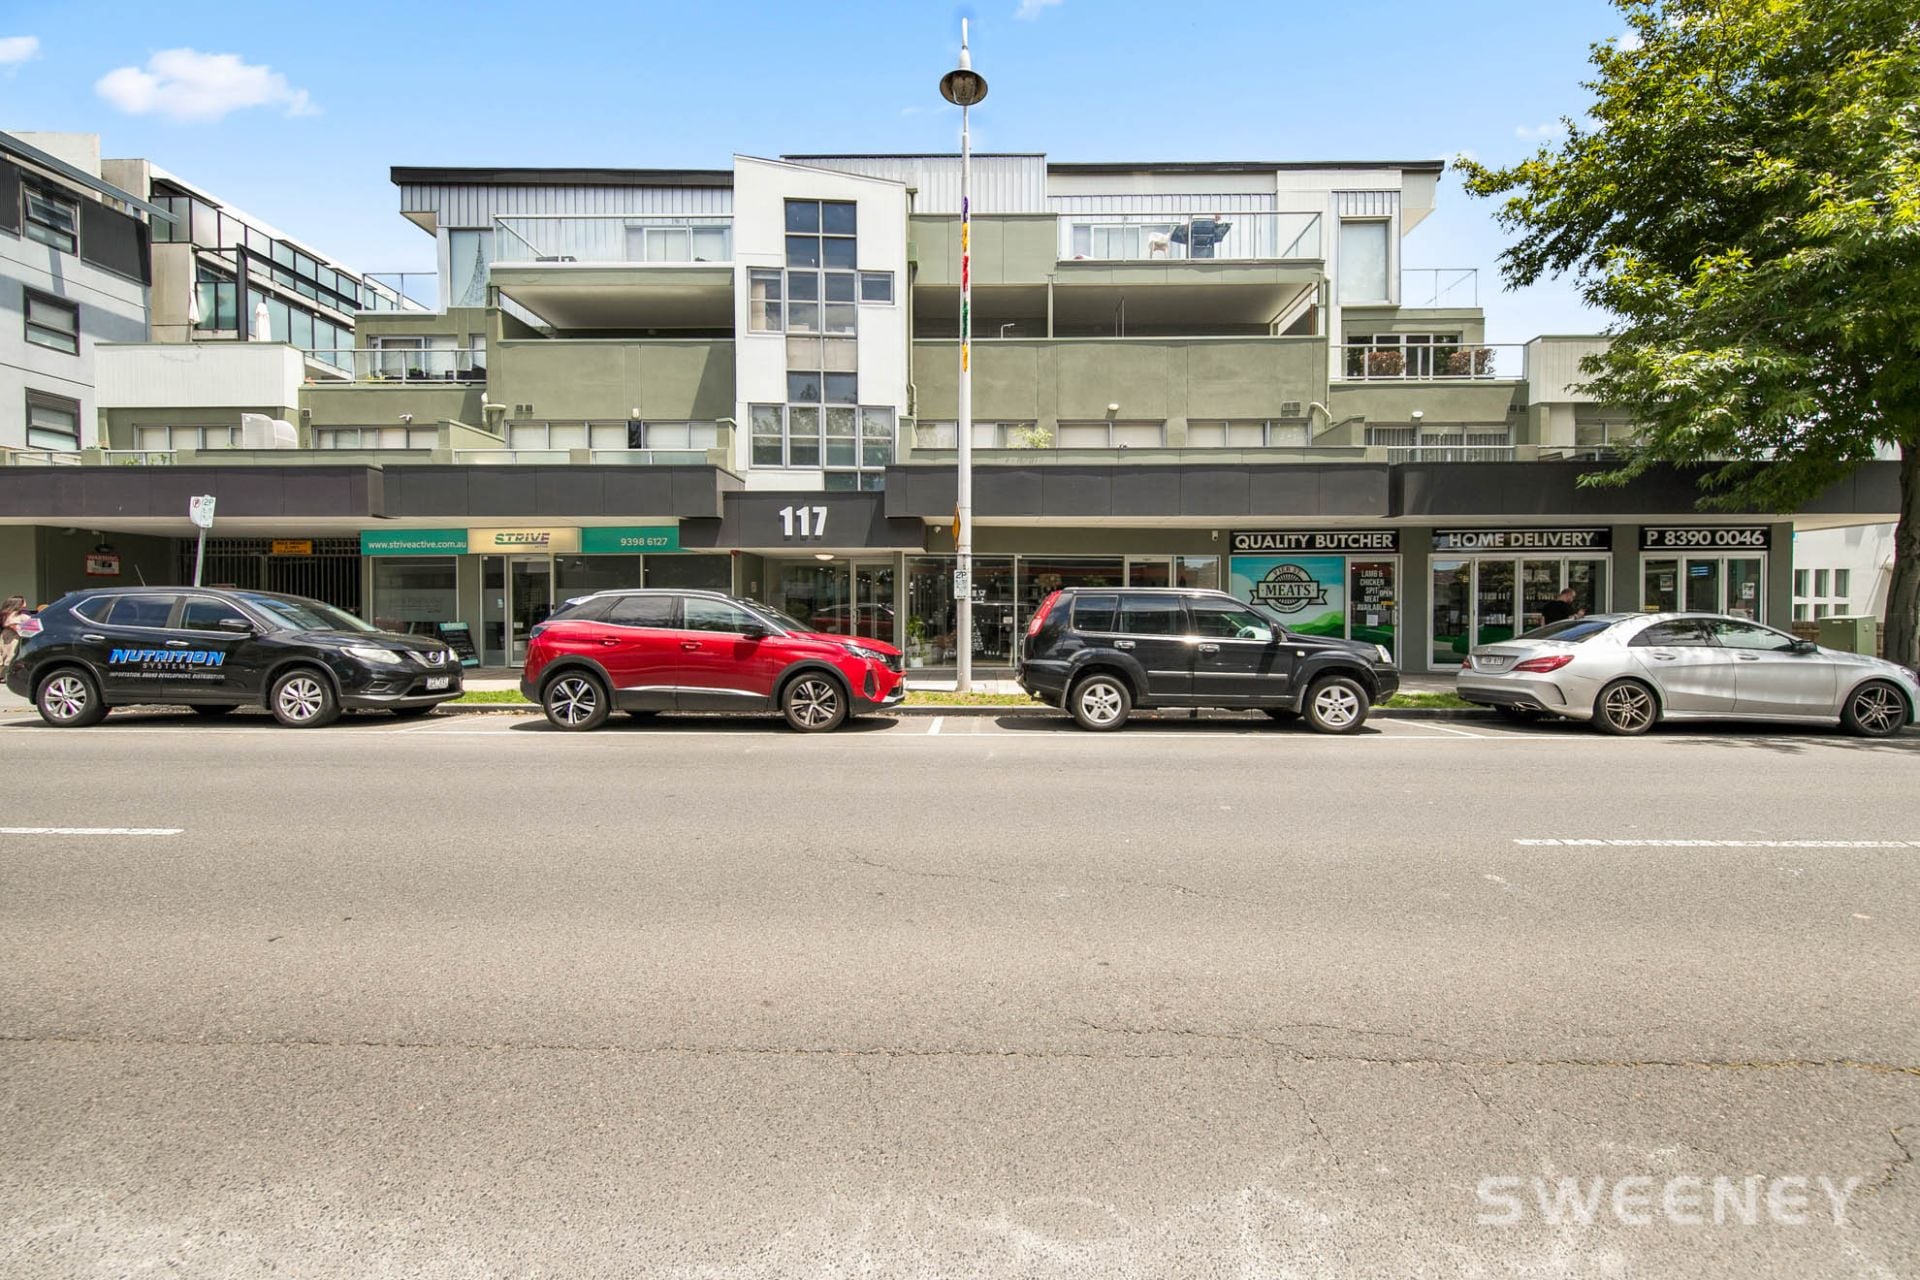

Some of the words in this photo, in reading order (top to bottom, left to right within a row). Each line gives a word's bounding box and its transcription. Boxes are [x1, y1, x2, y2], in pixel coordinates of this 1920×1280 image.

[779, 506, 828, 537] 117
[495, 533, 550, 542] STRIVE
[620, 537, 645, 546] 9398
[646, 537, 668, 546] 6127
[1235, 534, 1310, 549] QUALITY
[1315, 534, 1393, 548] BUTCHER
[1448, 532, 1504, 547] HOME
[1511, 532, 1595, 547] DELIVERY
[1646, 531, 1658, 546] P
[1664, 531, 1711, 546] 8390
[1715, 530, 1764, 545] 0046
[368, 540, 467, 549] www.striveactive.com.au
[955, 571, 967, 579] 2P
[1361, 569, 1378, 578] LAMB
[1360, 578, 1385, 586] CHICKEN
[1265, 584, 1311, 597] MEATS
[1365, 586, 1378, 595] SPIT
[1379, 589, 1393, 598] OPEN
[1363, 595, 1380, 603] MEAT
[1356, 603, 1387, 611] AVAILABLE
[109, 649, 226, 666] NUTRITION
[142, 662, 193, 671] SYSTEMS
